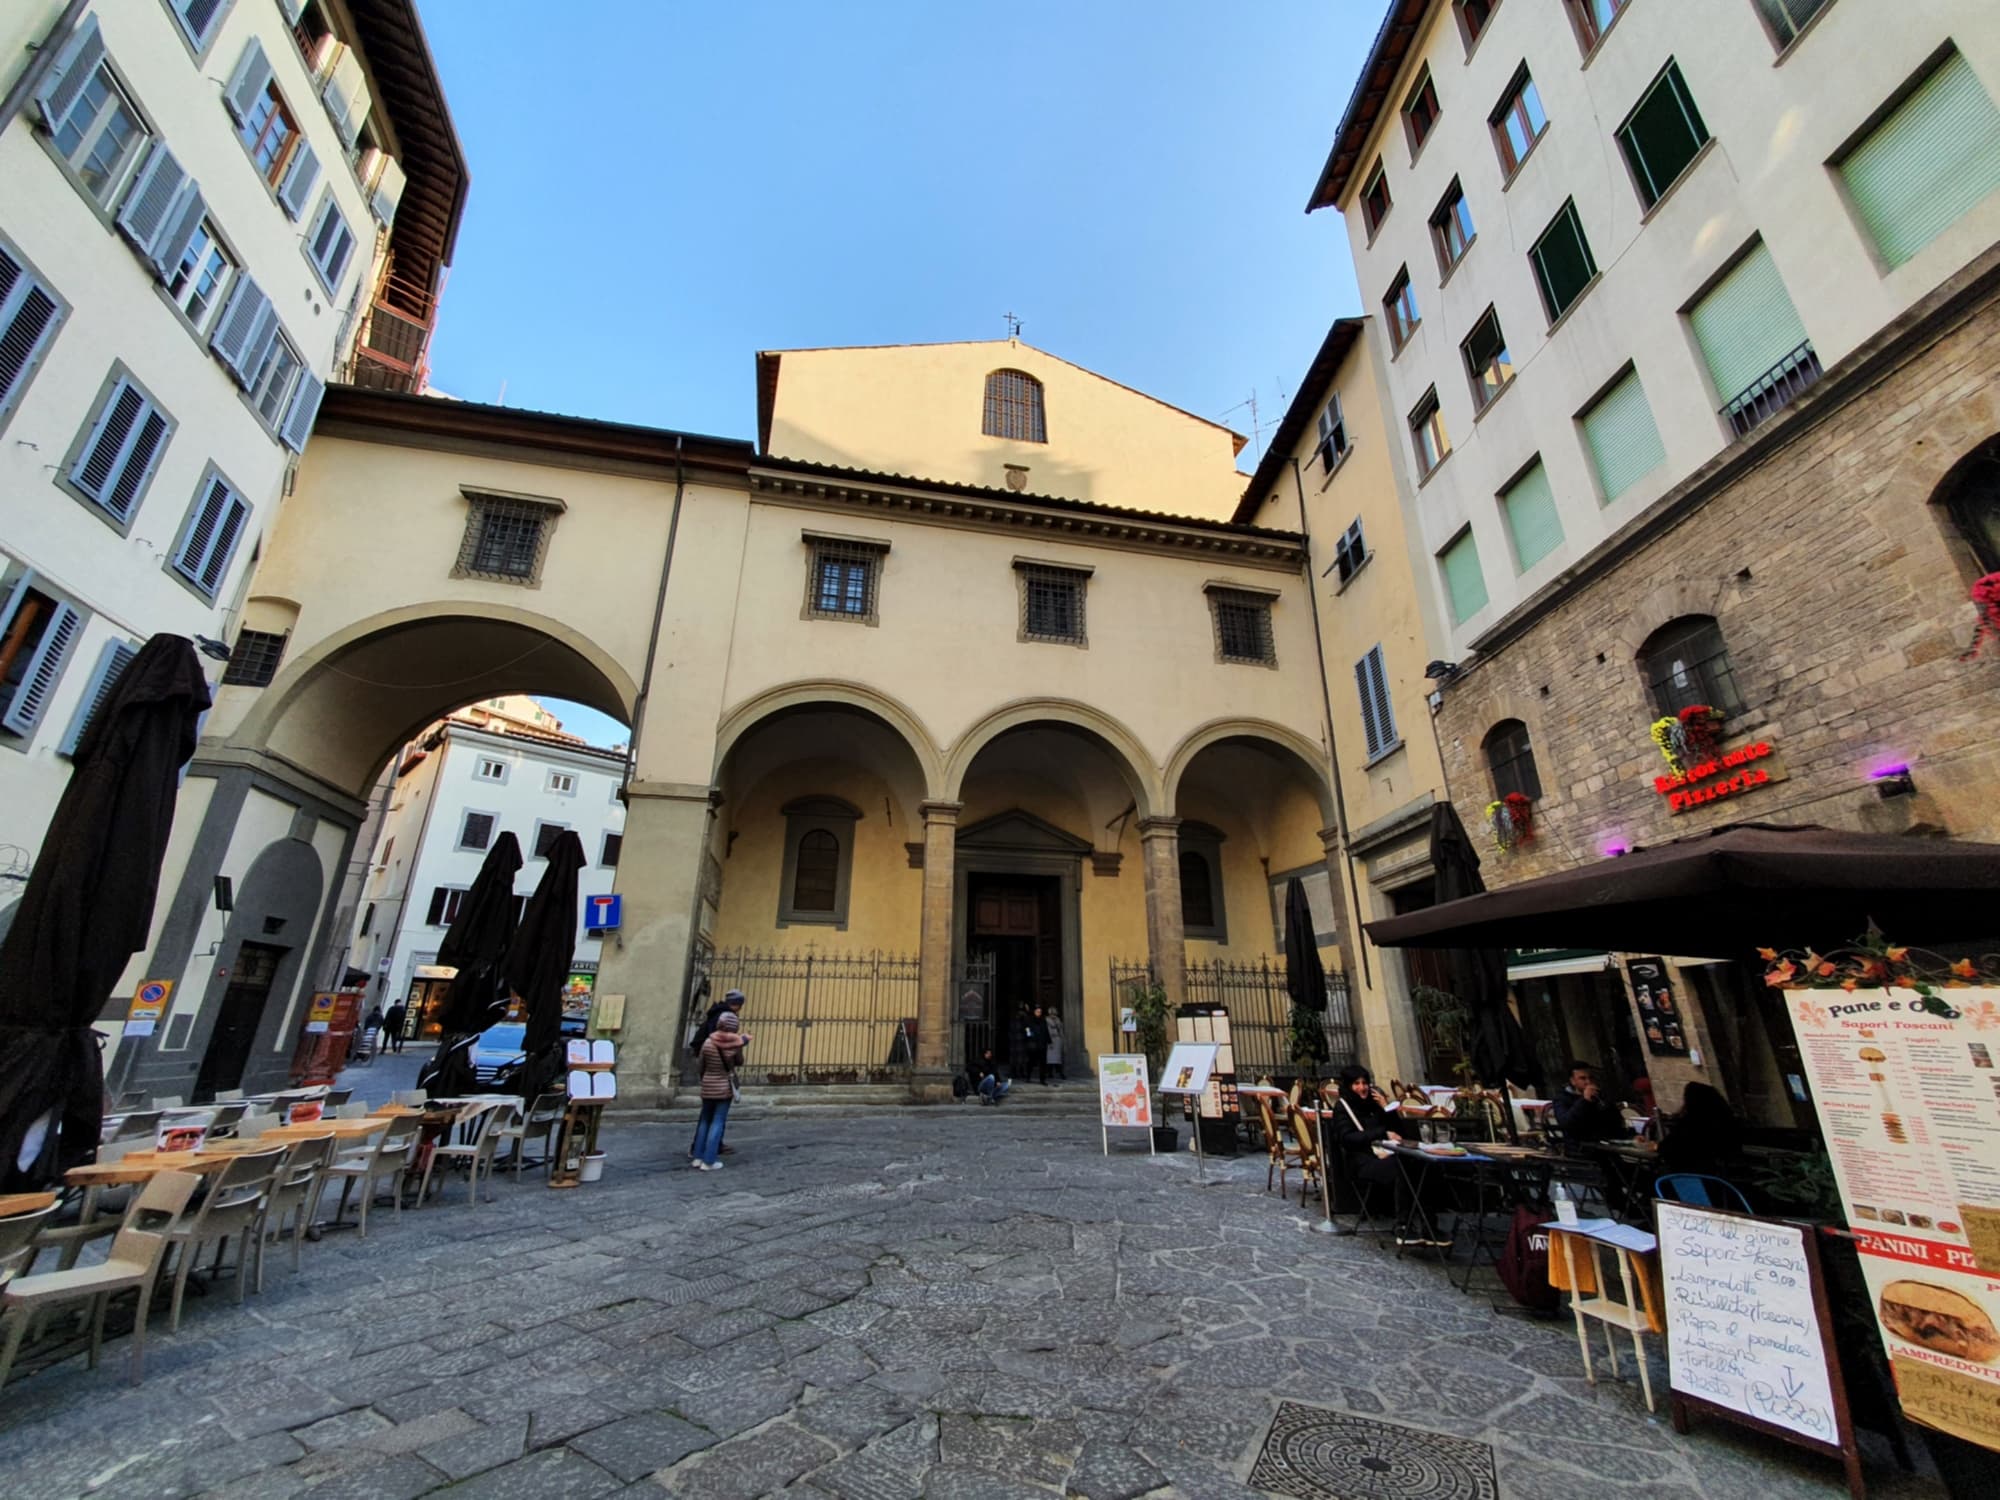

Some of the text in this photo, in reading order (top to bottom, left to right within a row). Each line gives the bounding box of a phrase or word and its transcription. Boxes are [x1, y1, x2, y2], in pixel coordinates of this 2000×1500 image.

[1668, 769, 1769, 811] Pizzeria
[1829, 1001, 1882, 1018] Pane
[1888, 1001, 1901, 1011] e
[1841, 1020, 1955, 1031] Sapori Toscani
[1527, 1234, 1549, 1251] VAN
[1675, 1236, 1741, 1267] Sapori
[1859, 1233, 1929, 1259] PANINI
[1946, 1248, 1979, 1269] PIZ
